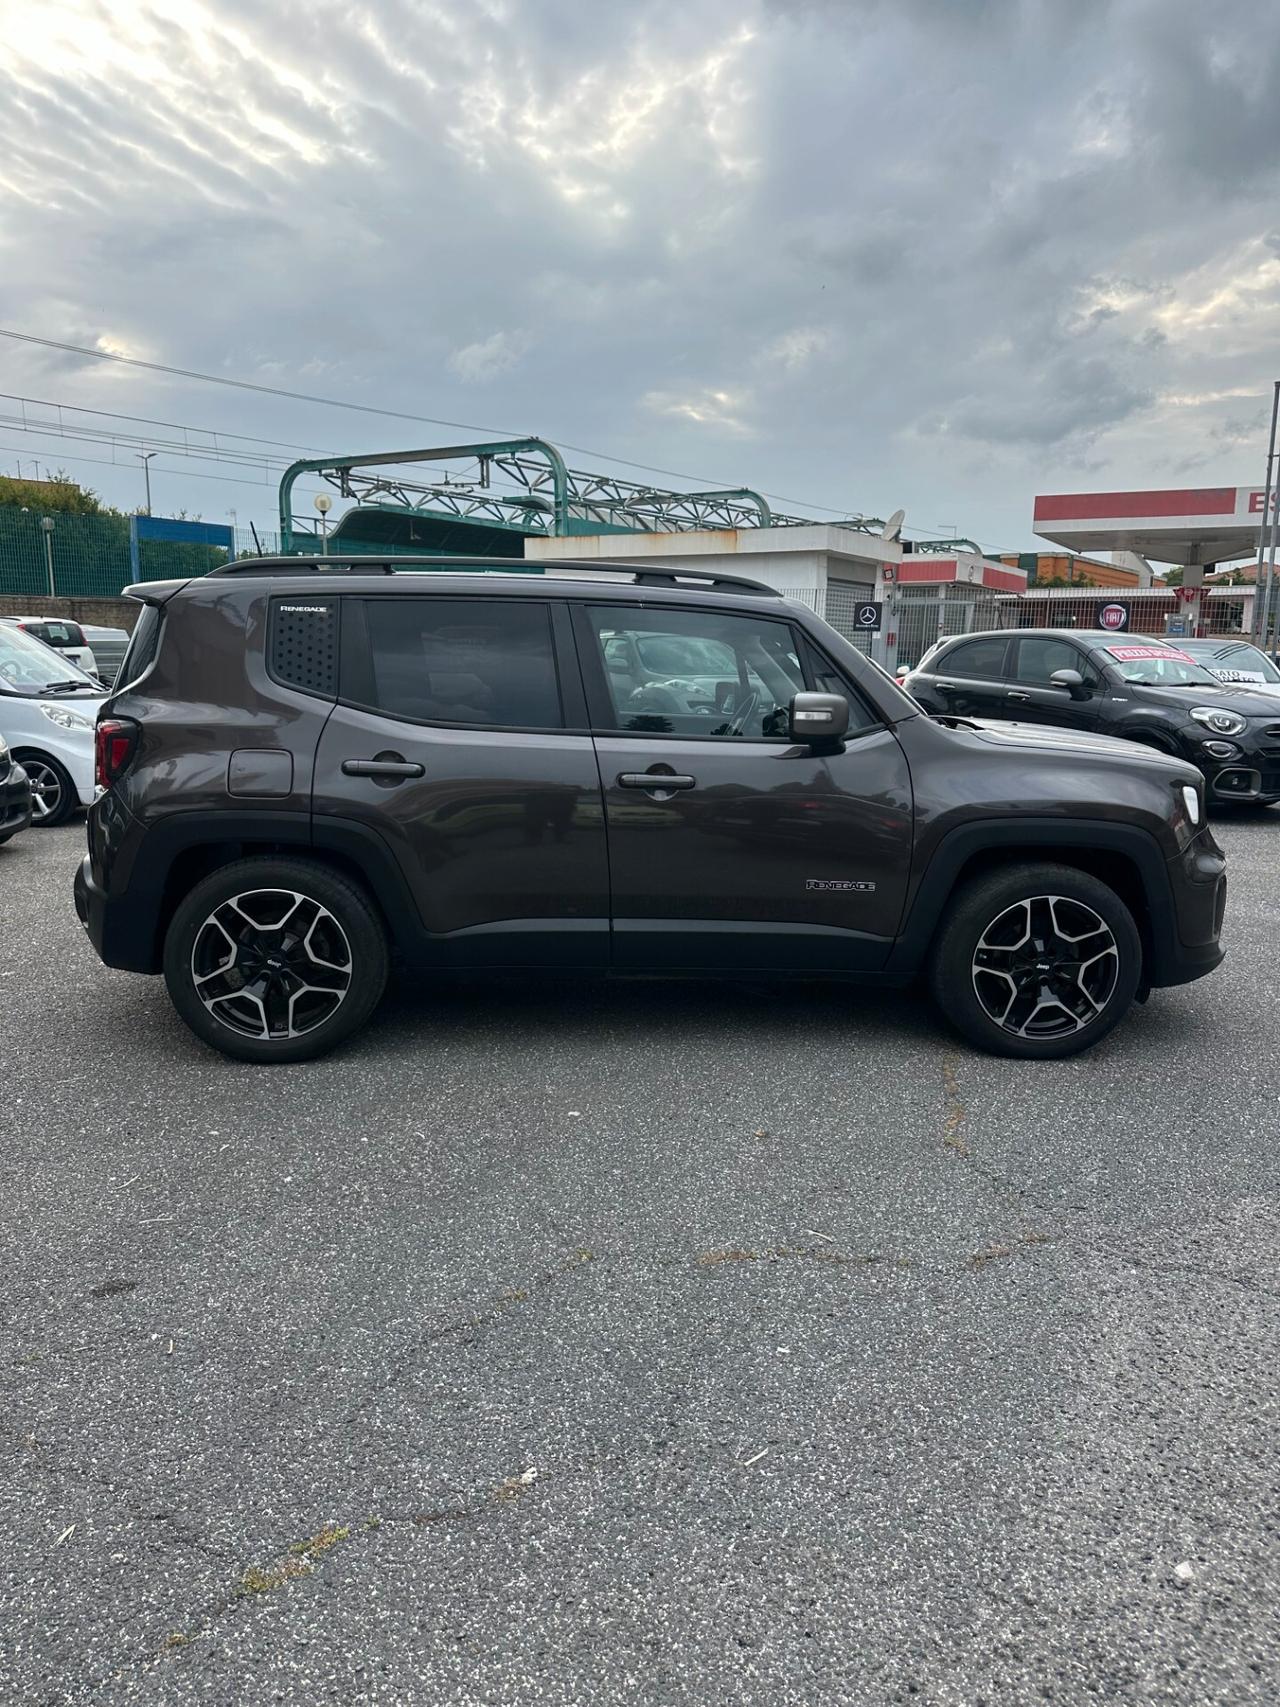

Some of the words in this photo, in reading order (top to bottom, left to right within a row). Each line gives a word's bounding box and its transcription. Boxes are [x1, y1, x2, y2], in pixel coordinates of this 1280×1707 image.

[280, 605, 328, 613] RENEGADE
[1105, 611, 1122, 624] FIAT
[806, 879, 876, 892] RENEGADE
